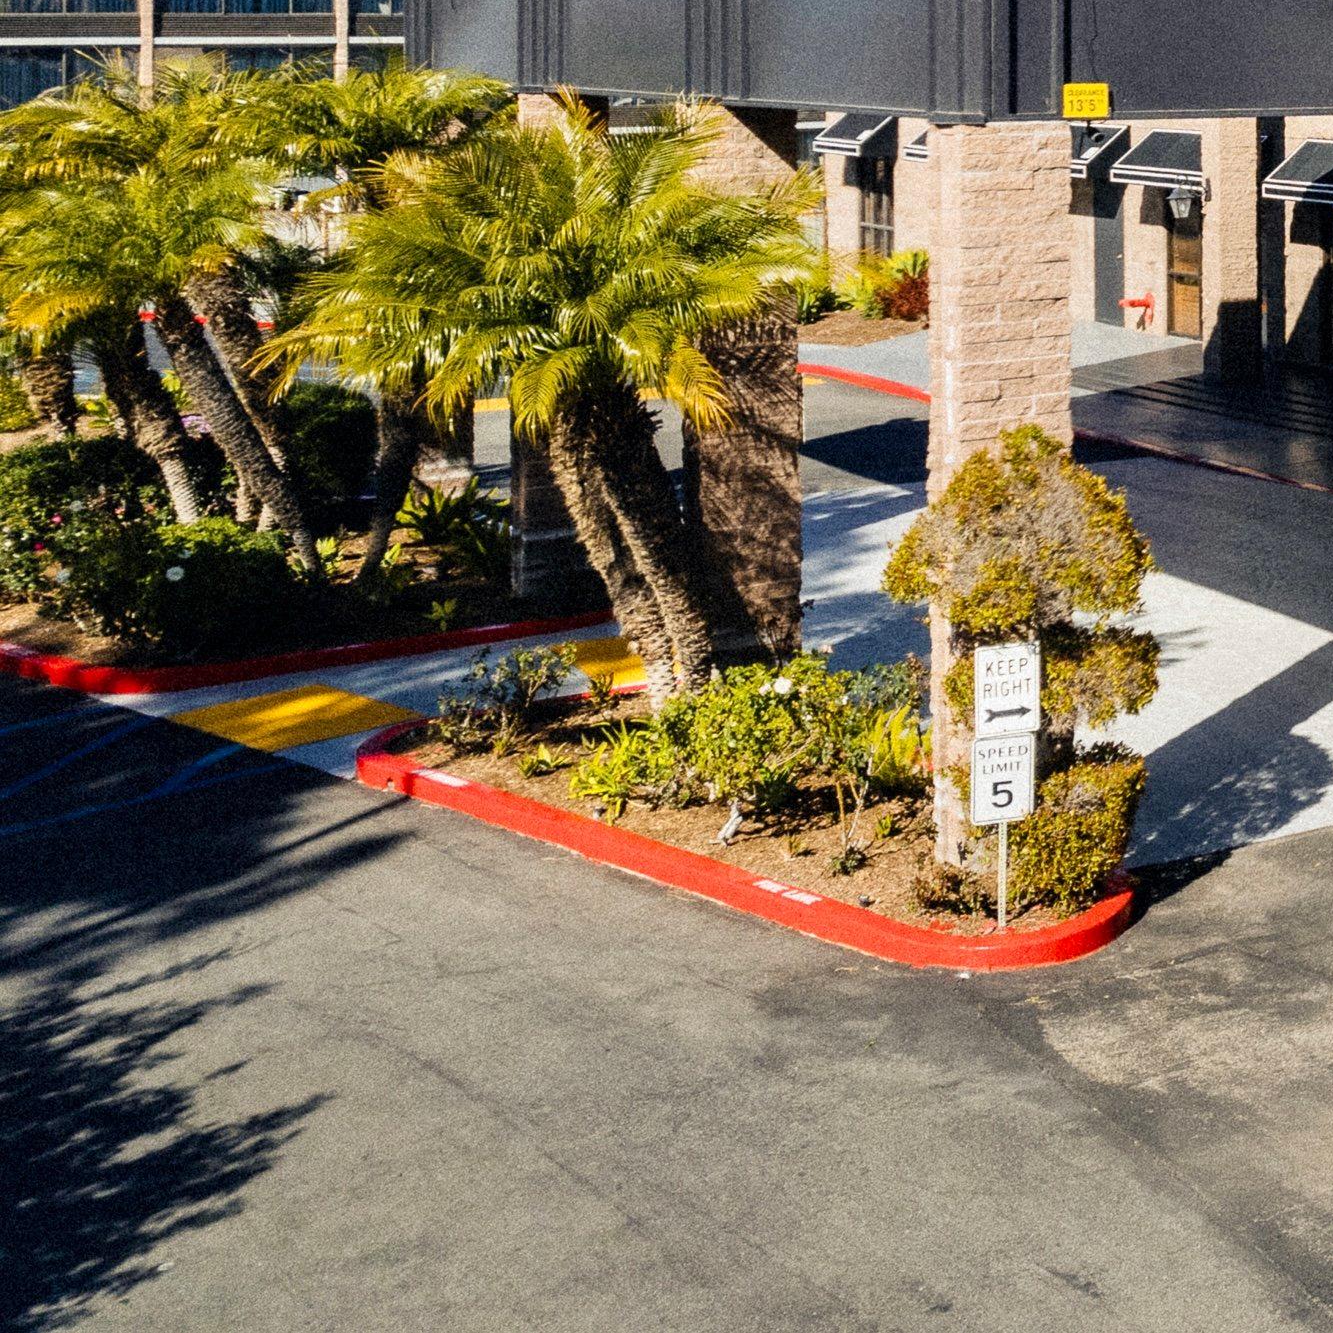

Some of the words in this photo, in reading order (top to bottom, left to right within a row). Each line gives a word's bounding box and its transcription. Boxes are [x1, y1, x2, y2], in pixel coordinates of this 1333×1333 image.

[985, 657, 1029, 678] KEEP
[983, 677, 1032, 699] RIGHT
[978, 744, 1029, 760] SPEED
[983, 761, 1022, 774] LIMIT
[991, 780, 1014, 808] 5
